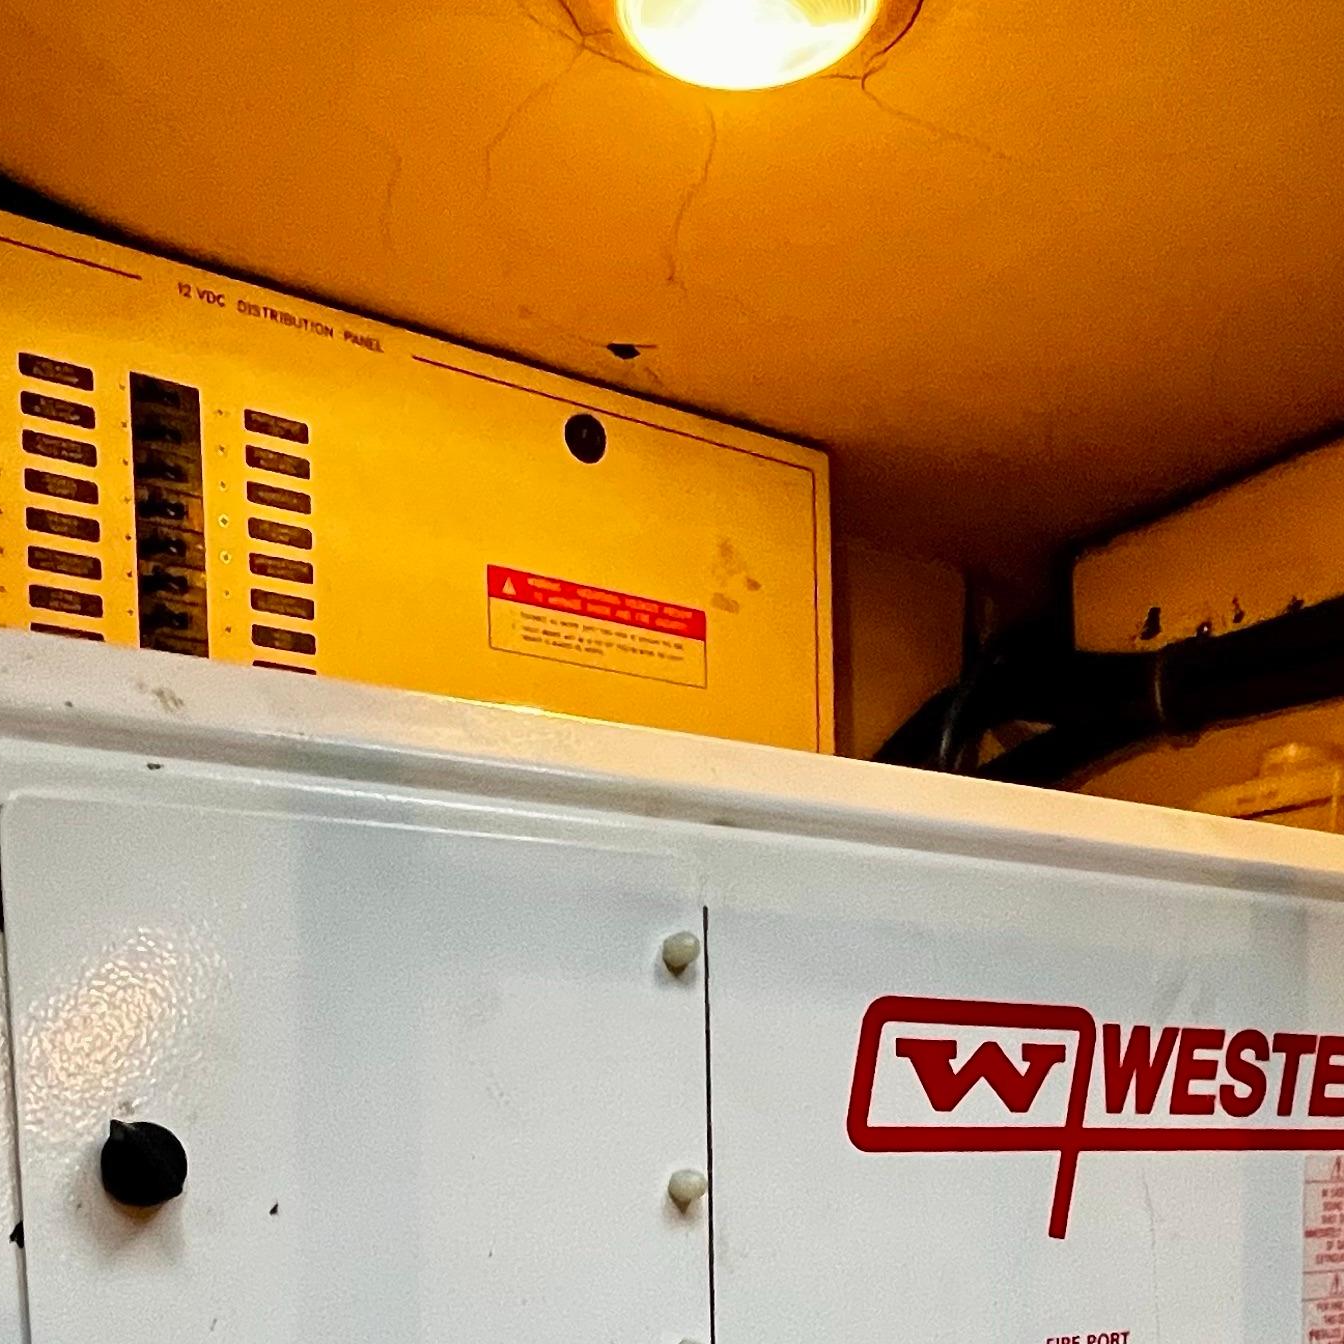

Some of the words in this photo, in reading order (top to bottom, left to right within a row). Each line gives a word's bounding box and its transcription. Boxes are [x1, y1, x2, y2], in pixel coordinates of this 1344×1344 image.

[177, 282, 192, 298] 12
[196, 287, 225, 307] VDC
[237, 300, 334, 338] DISTRIBUTION
[343, 330, 384, 353] PANEL
